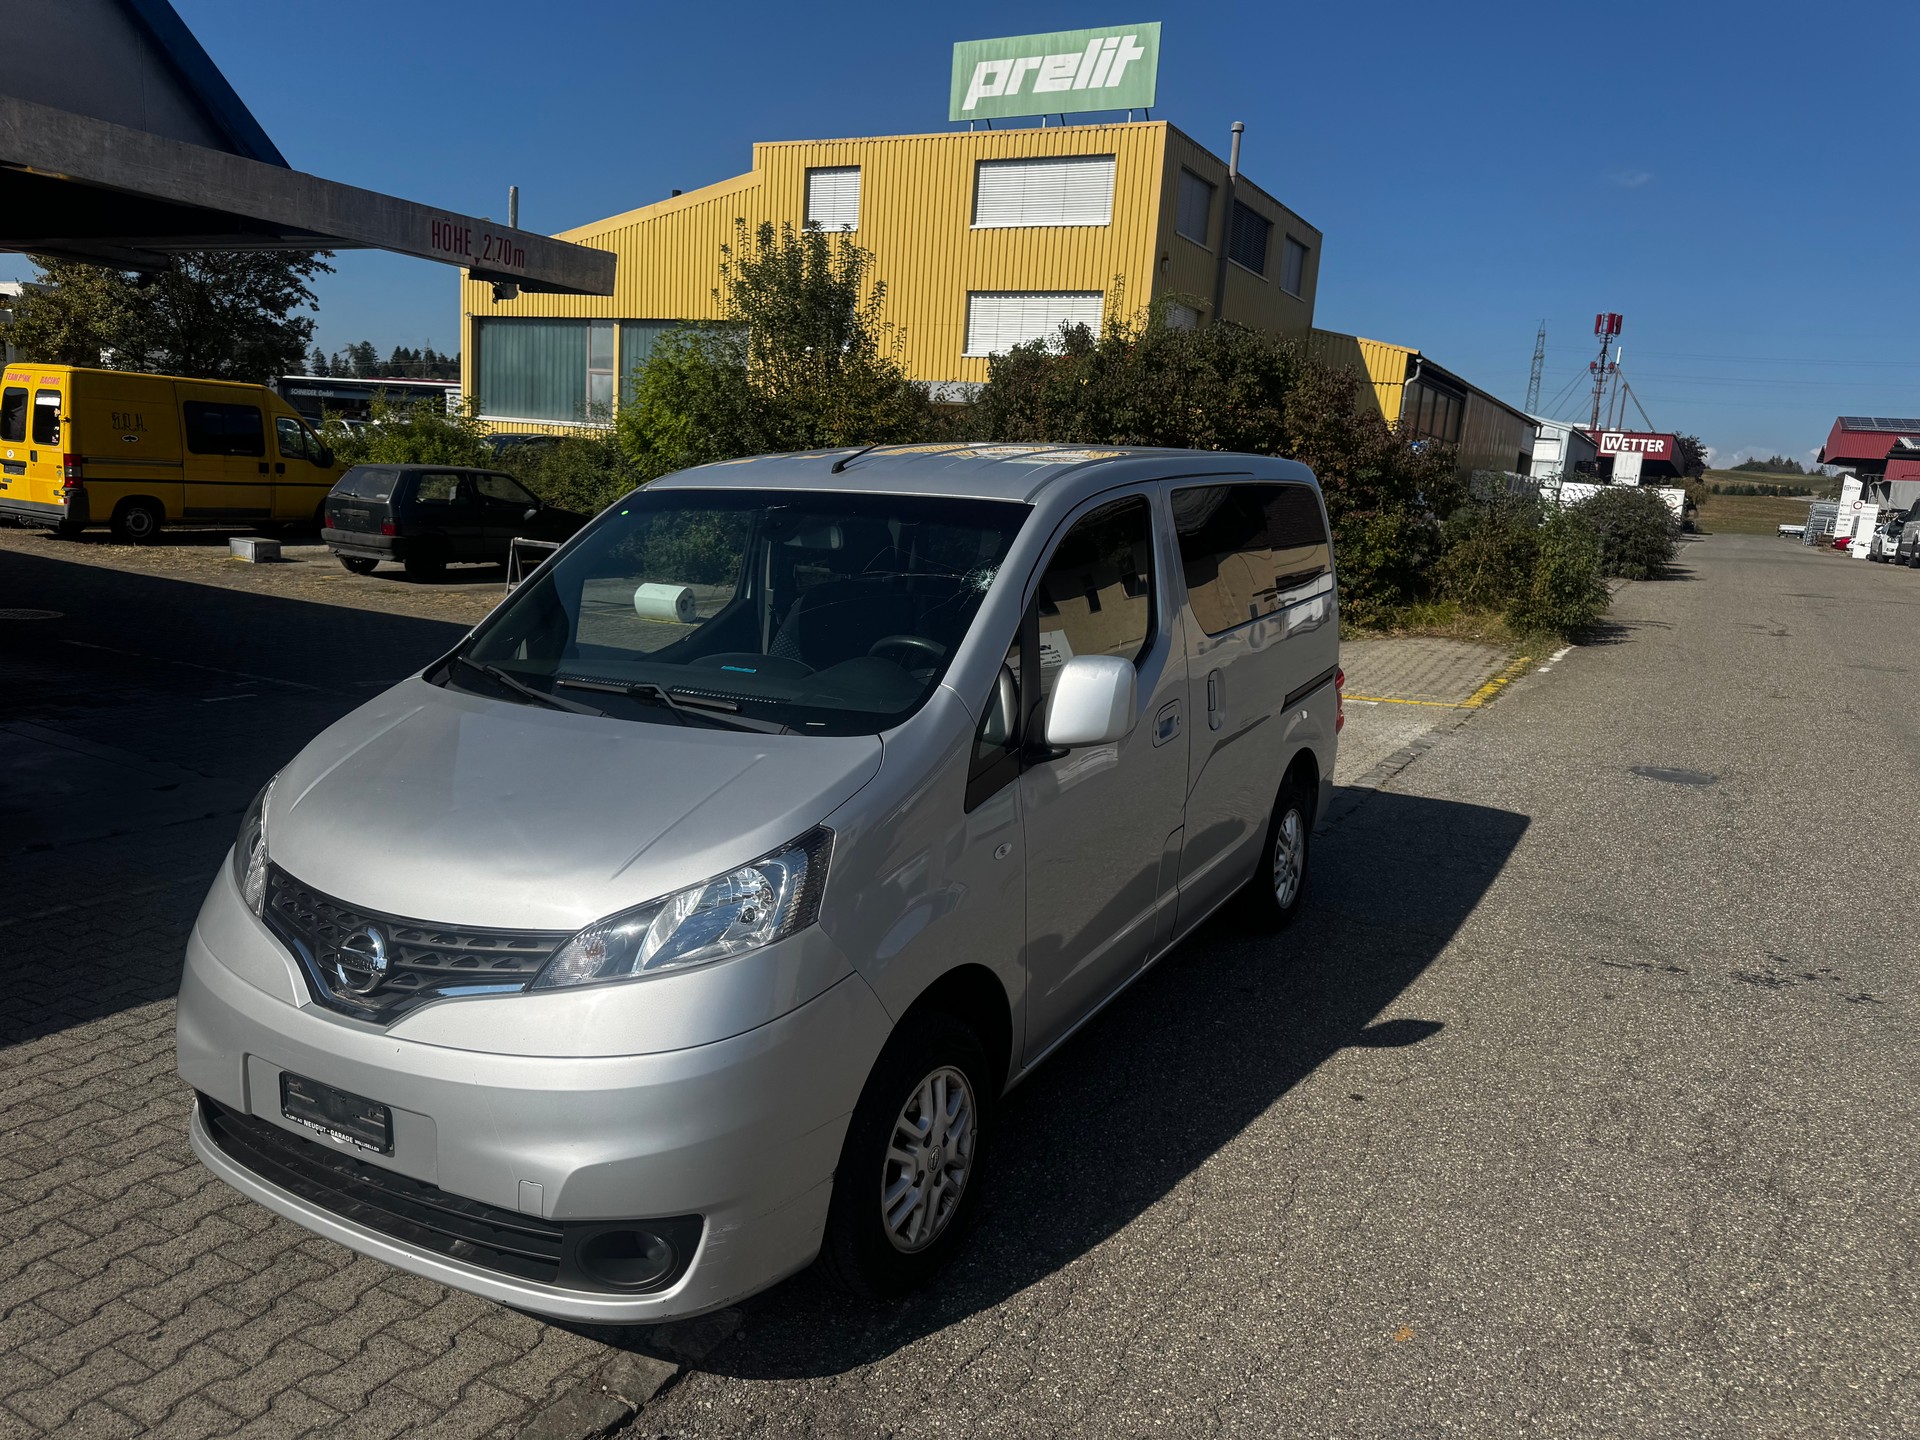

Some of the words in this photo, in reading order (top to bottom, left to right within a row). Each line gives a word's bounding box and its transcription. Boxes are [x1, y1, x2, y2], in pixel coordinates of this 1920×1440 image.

[962, 34, 1145, 111] prelit
[431, 217, 472, 257] HÖHE
[1602, 434, 1665, 454] WETTER
